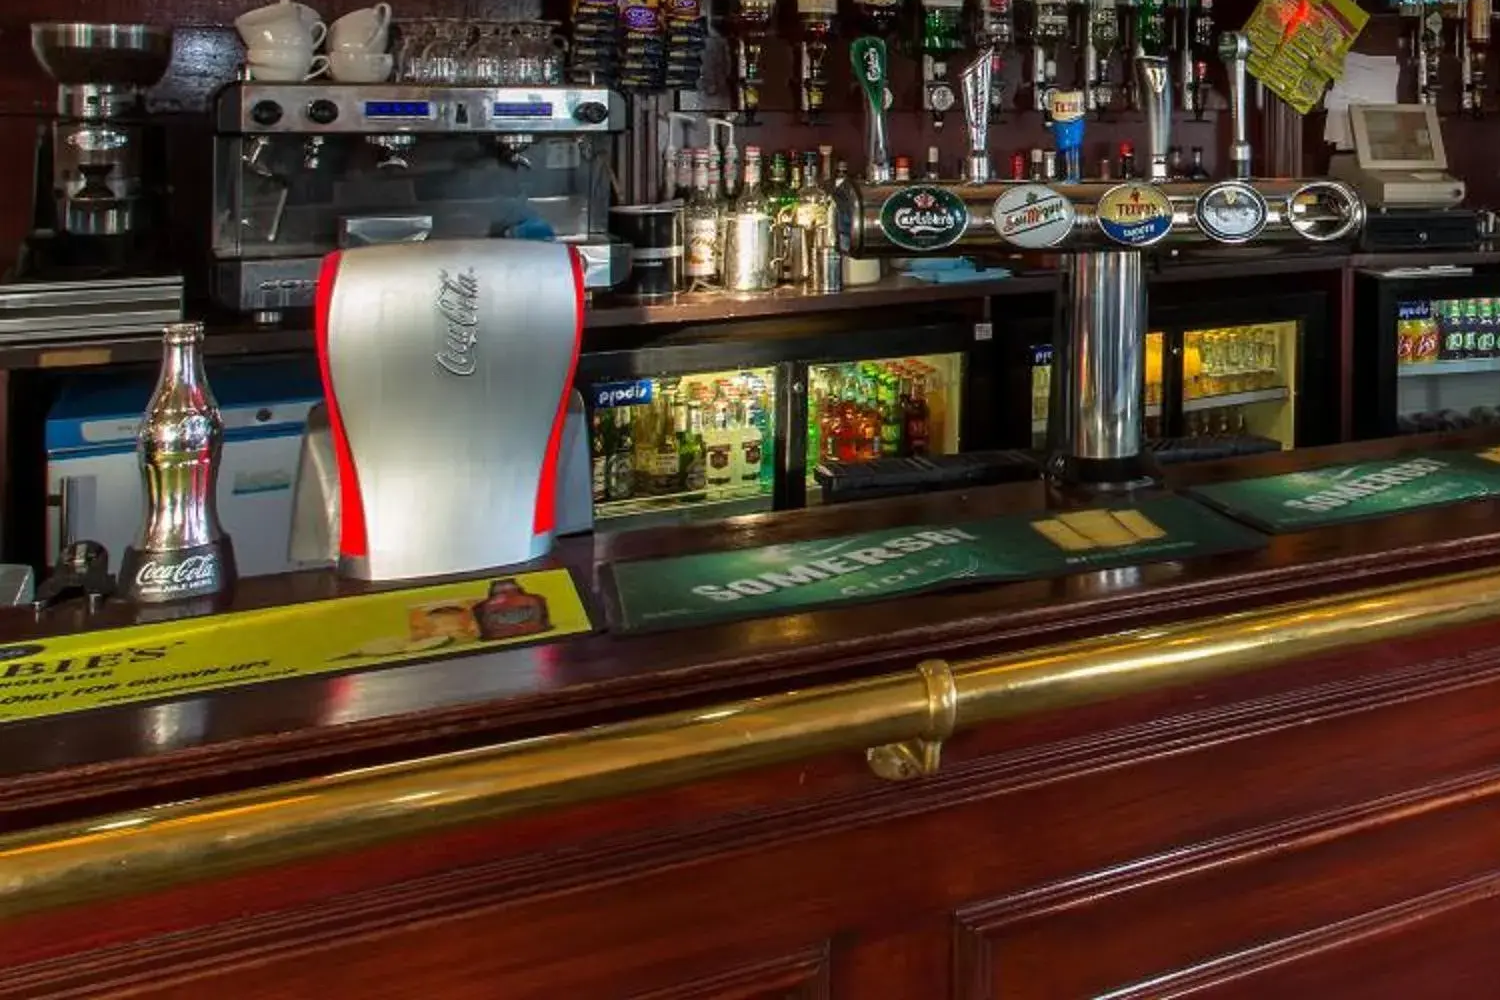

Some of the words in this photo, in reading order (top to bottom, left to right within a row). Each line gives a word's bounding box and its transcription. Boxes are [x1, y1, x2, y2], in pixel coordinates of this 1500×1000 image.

[894, 207, 955, 230] Carlsberg
[135, 553, 216, 585] Coca-Cola
[693, 526, 980, 601] SOMERSBY
